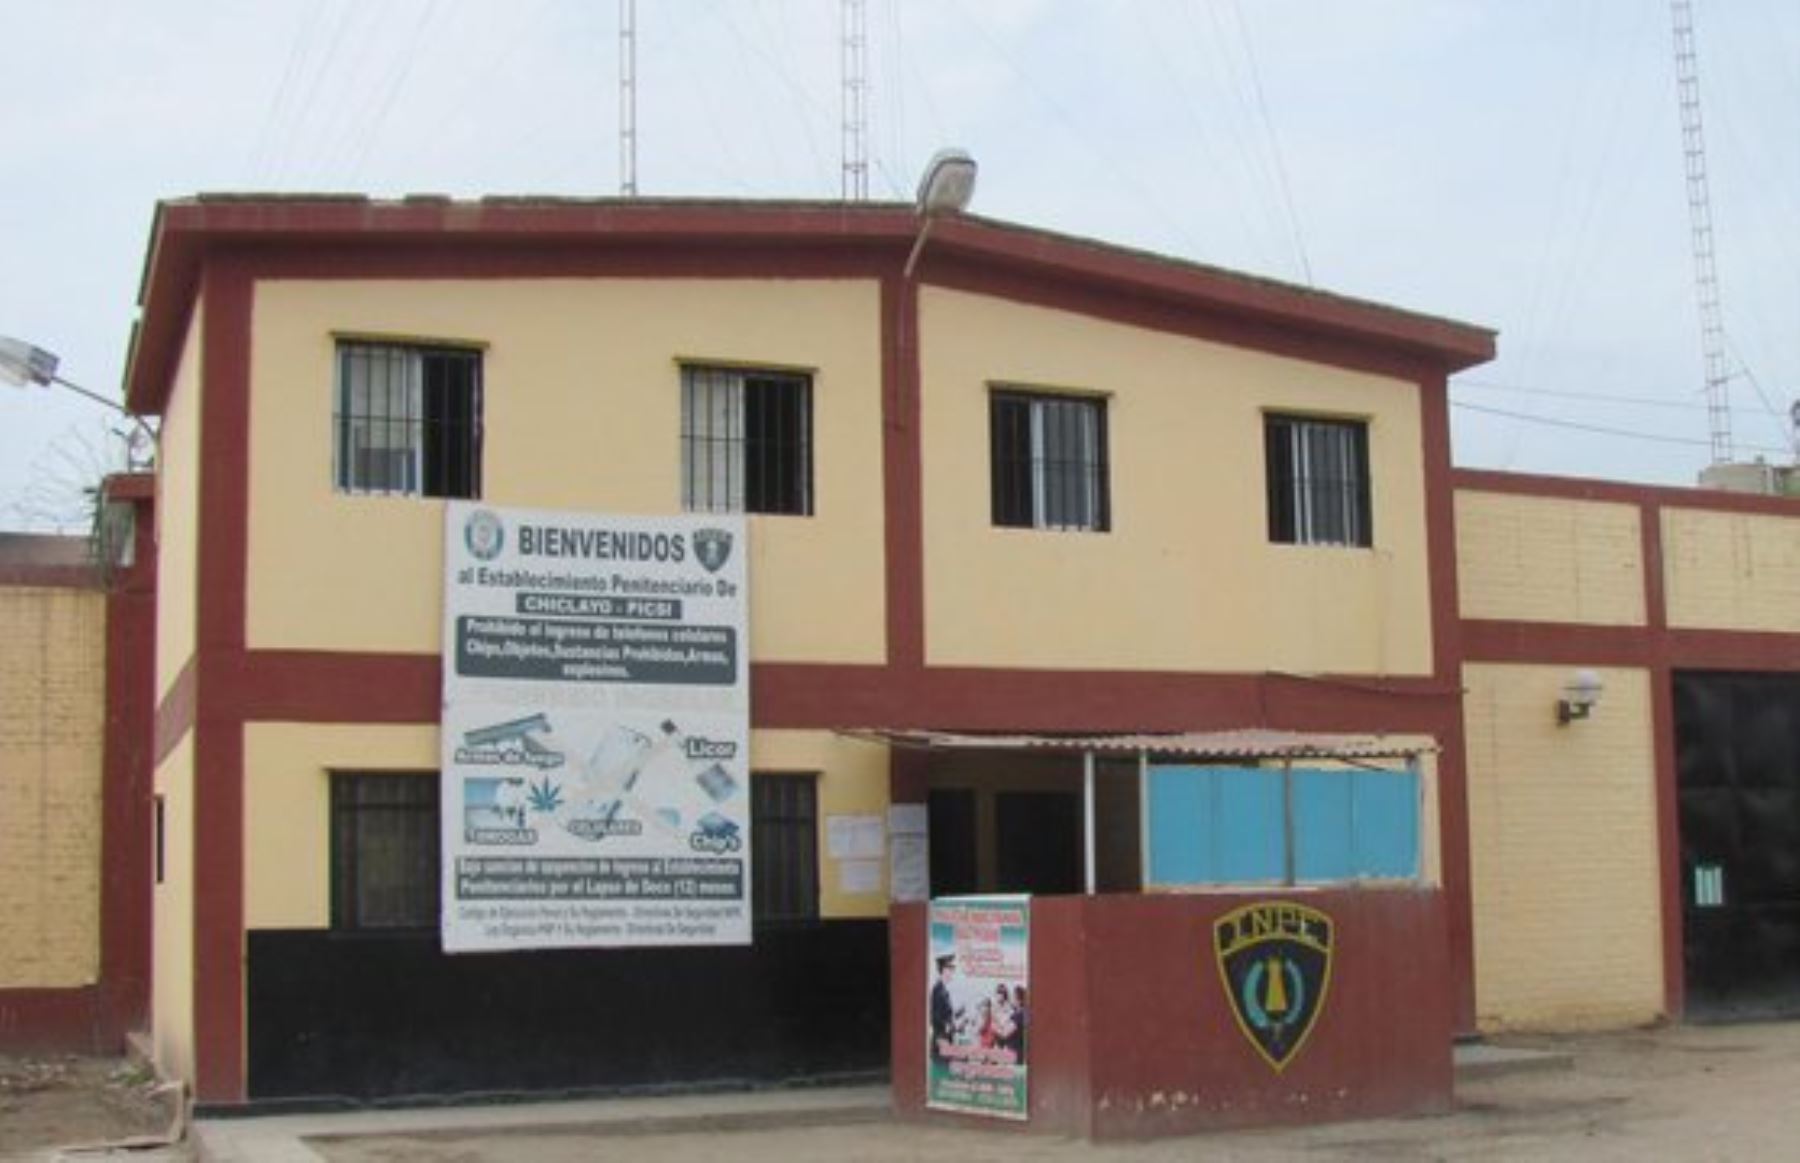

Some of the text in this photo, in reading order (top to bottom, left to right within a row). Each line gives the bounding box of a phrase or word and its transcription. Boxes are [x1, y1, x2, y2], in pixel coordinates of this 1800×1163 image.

[518, 524, 686, 563] BIENVENIDOS
[457, 566, 737, 598] al Establecimiento Penitenciario De
[524, 595, 613, 615] CHICLAYO
[627, 600, 673, 618] PICSI
[687, 736, 736, 759] Licor
